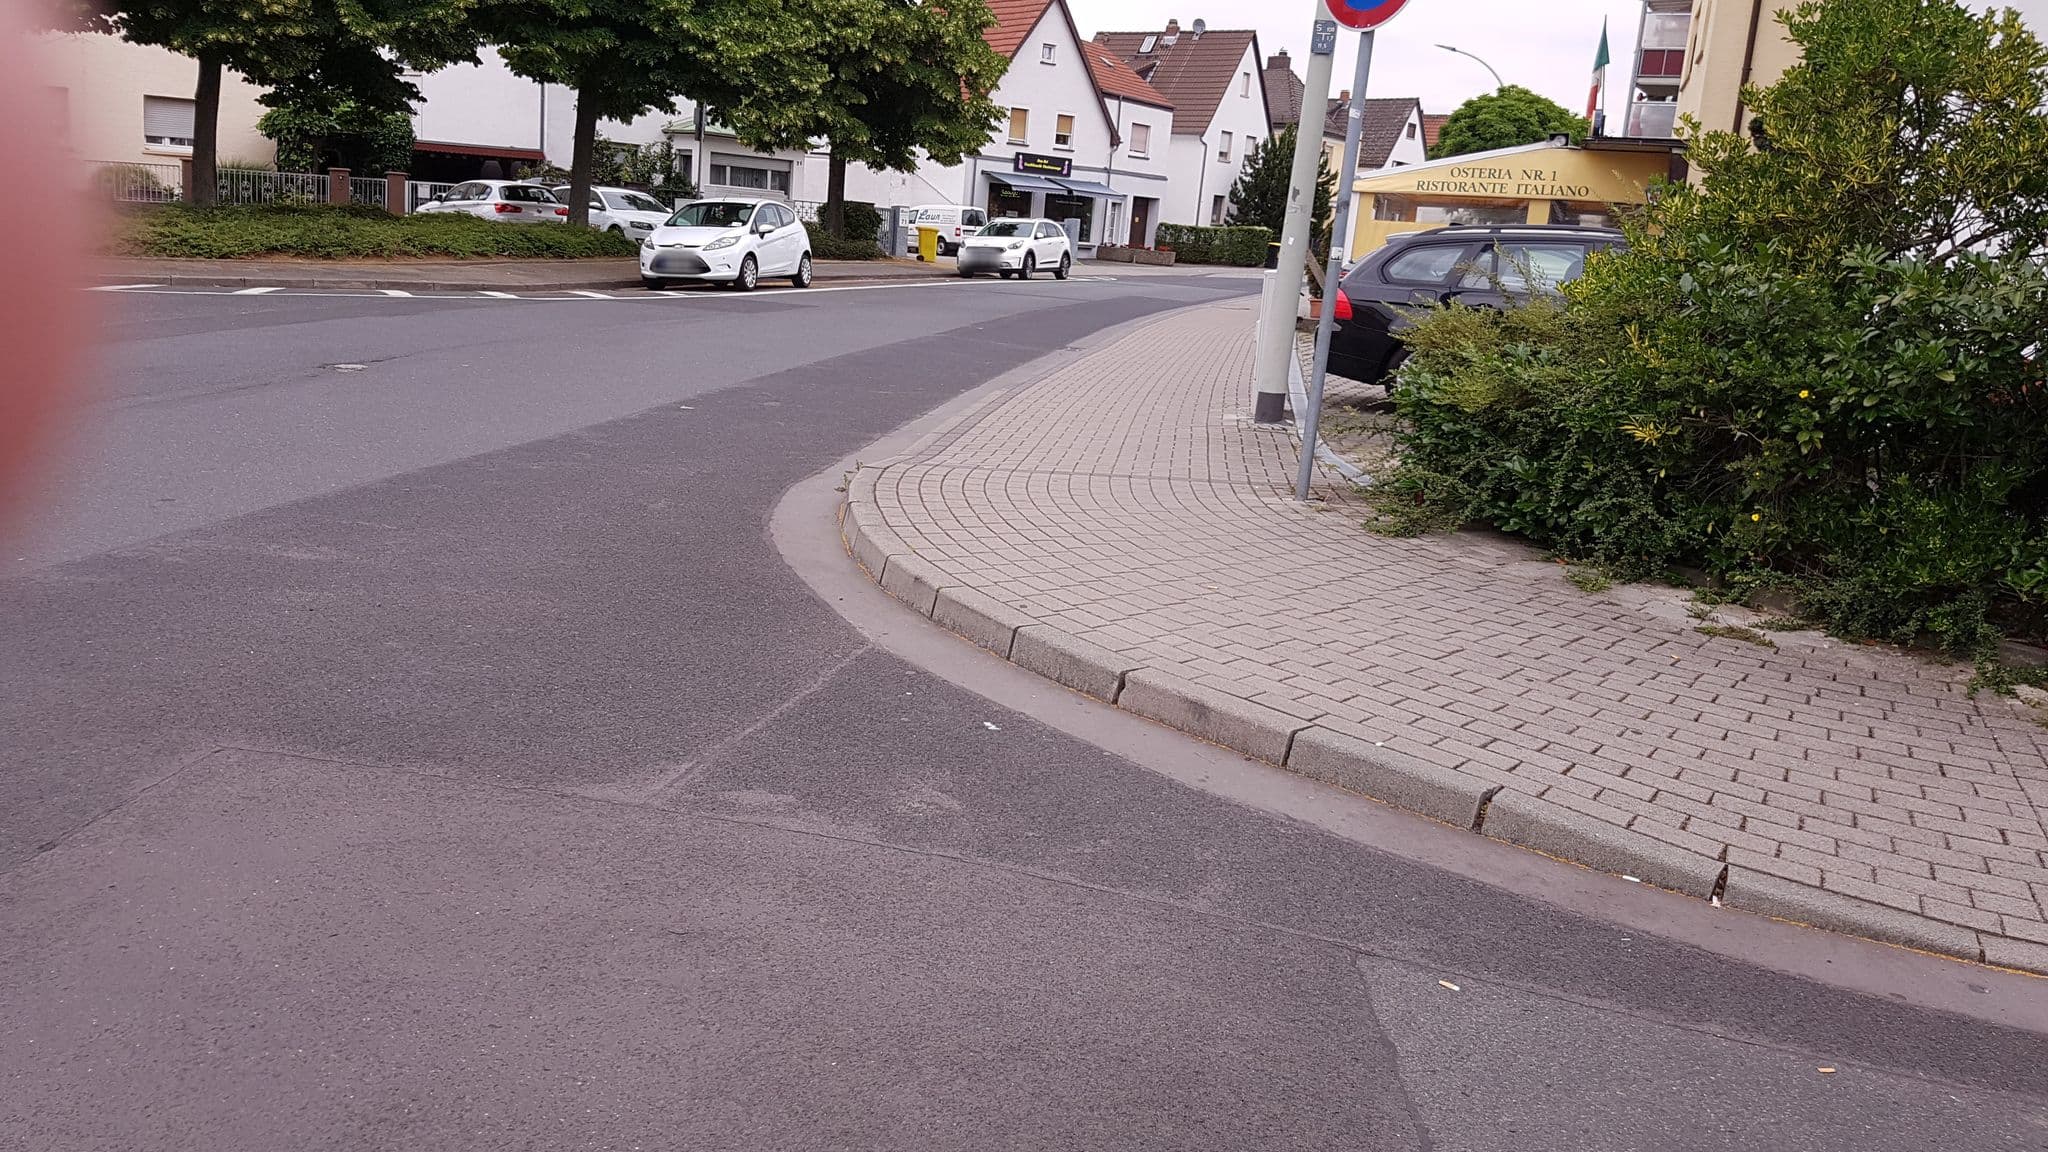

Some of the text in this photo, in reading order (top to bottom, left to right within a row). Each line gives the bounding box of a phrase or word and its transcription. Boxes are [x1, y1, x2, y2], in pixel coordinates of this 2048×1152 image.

[1450, 167, 1557, 181] OSTERIA NR. 1
[1416, 181, 1589, 197] RISTORANTE ITALIANO
